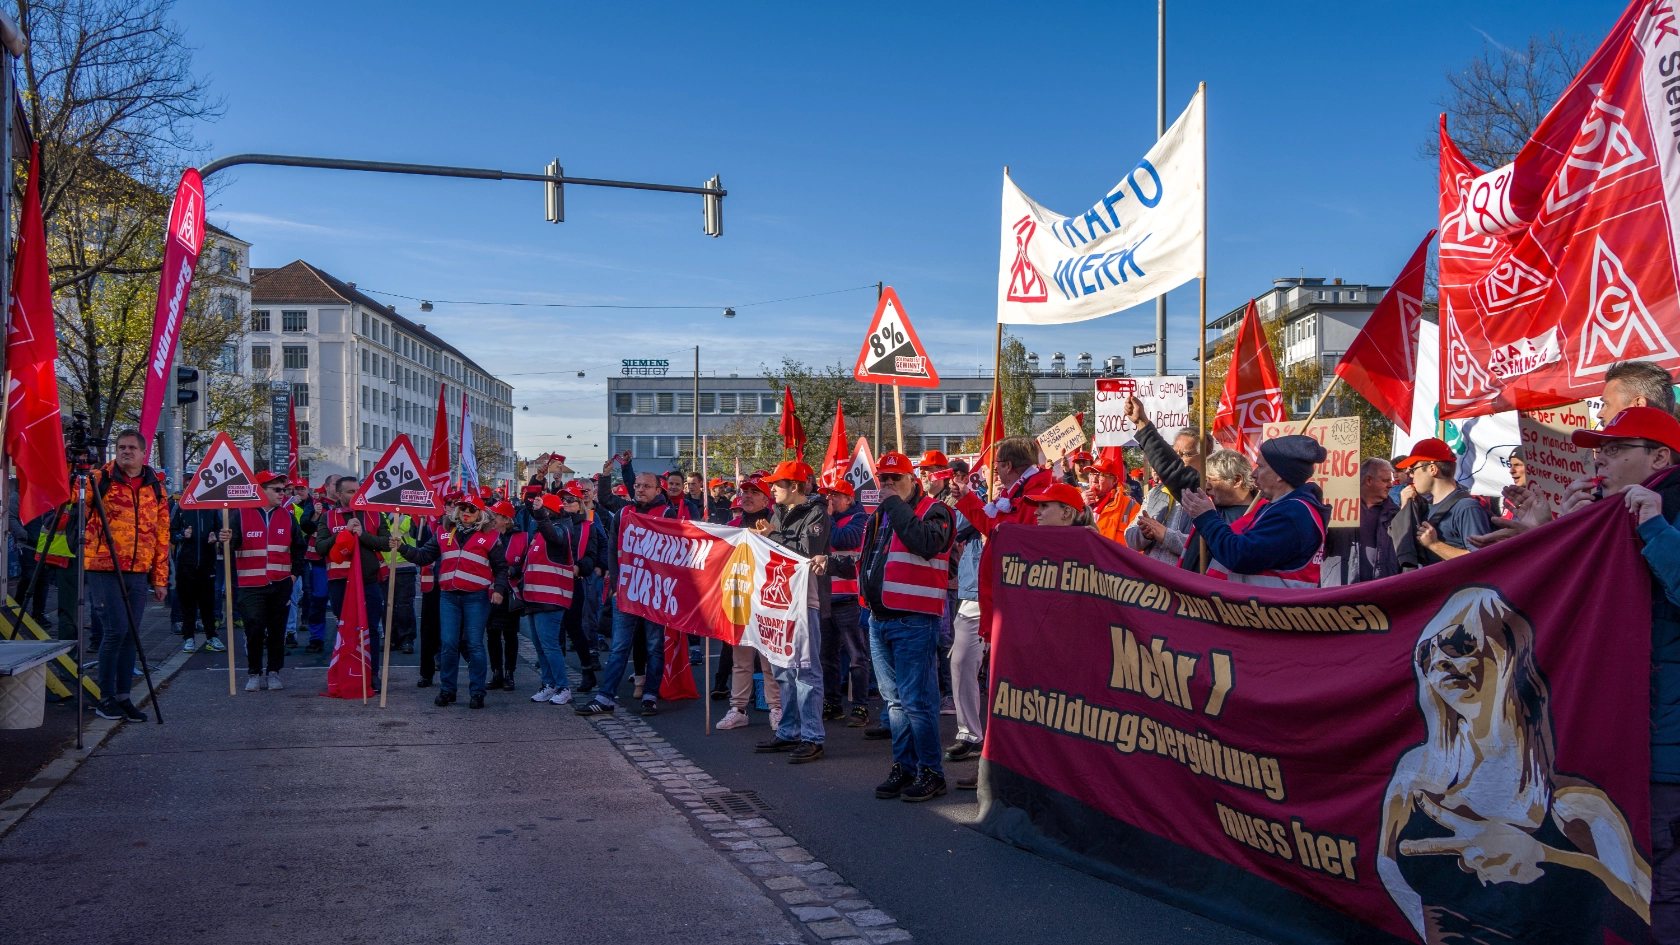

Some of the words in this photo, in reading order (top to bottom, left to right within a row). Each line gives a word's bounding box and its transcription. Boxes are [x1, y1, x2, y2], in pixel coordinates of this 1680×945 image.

[1053, 233, 1152, 300] WERK
[152, 256, 192, 380] Nürnberg
[870, 322, 904, 357] 8%
[1491, 354, 1538, 376] SIEMENS
[1136, 381, 1154, 398] icht
[1156, 410, 1189, 429] Betrug
[1560, 408, 1586, 428] vbm
[200, 459, 237, 488] 8%
[375, 462, 414, 490] 8%
[1525, 445, 1537, 462] ist
[1570, 461, 1586, 474] an
[1526, 464, 1552, 479] seiner
[622, 524, 714, 570] GEMEINSAM
[620, 557, 652, 606] FÜR
[652, 574, 678, 616] 8%
[1002, 556, 1026, 586] Für
[1028, 562, 1057, 590] ein
[1060, 562, 1172, 611] Einkommen
[1175, 591, 1219, 622] zum
[1219, 595, 1390, 632] Auskommen
[1110, 625, 1197, 710] Mehr
[994, 682, 1284, 801] Ausbildungsvergütung
[1216, 802, 1292, 859] muss
[1293, 821, 1356, 880] her
